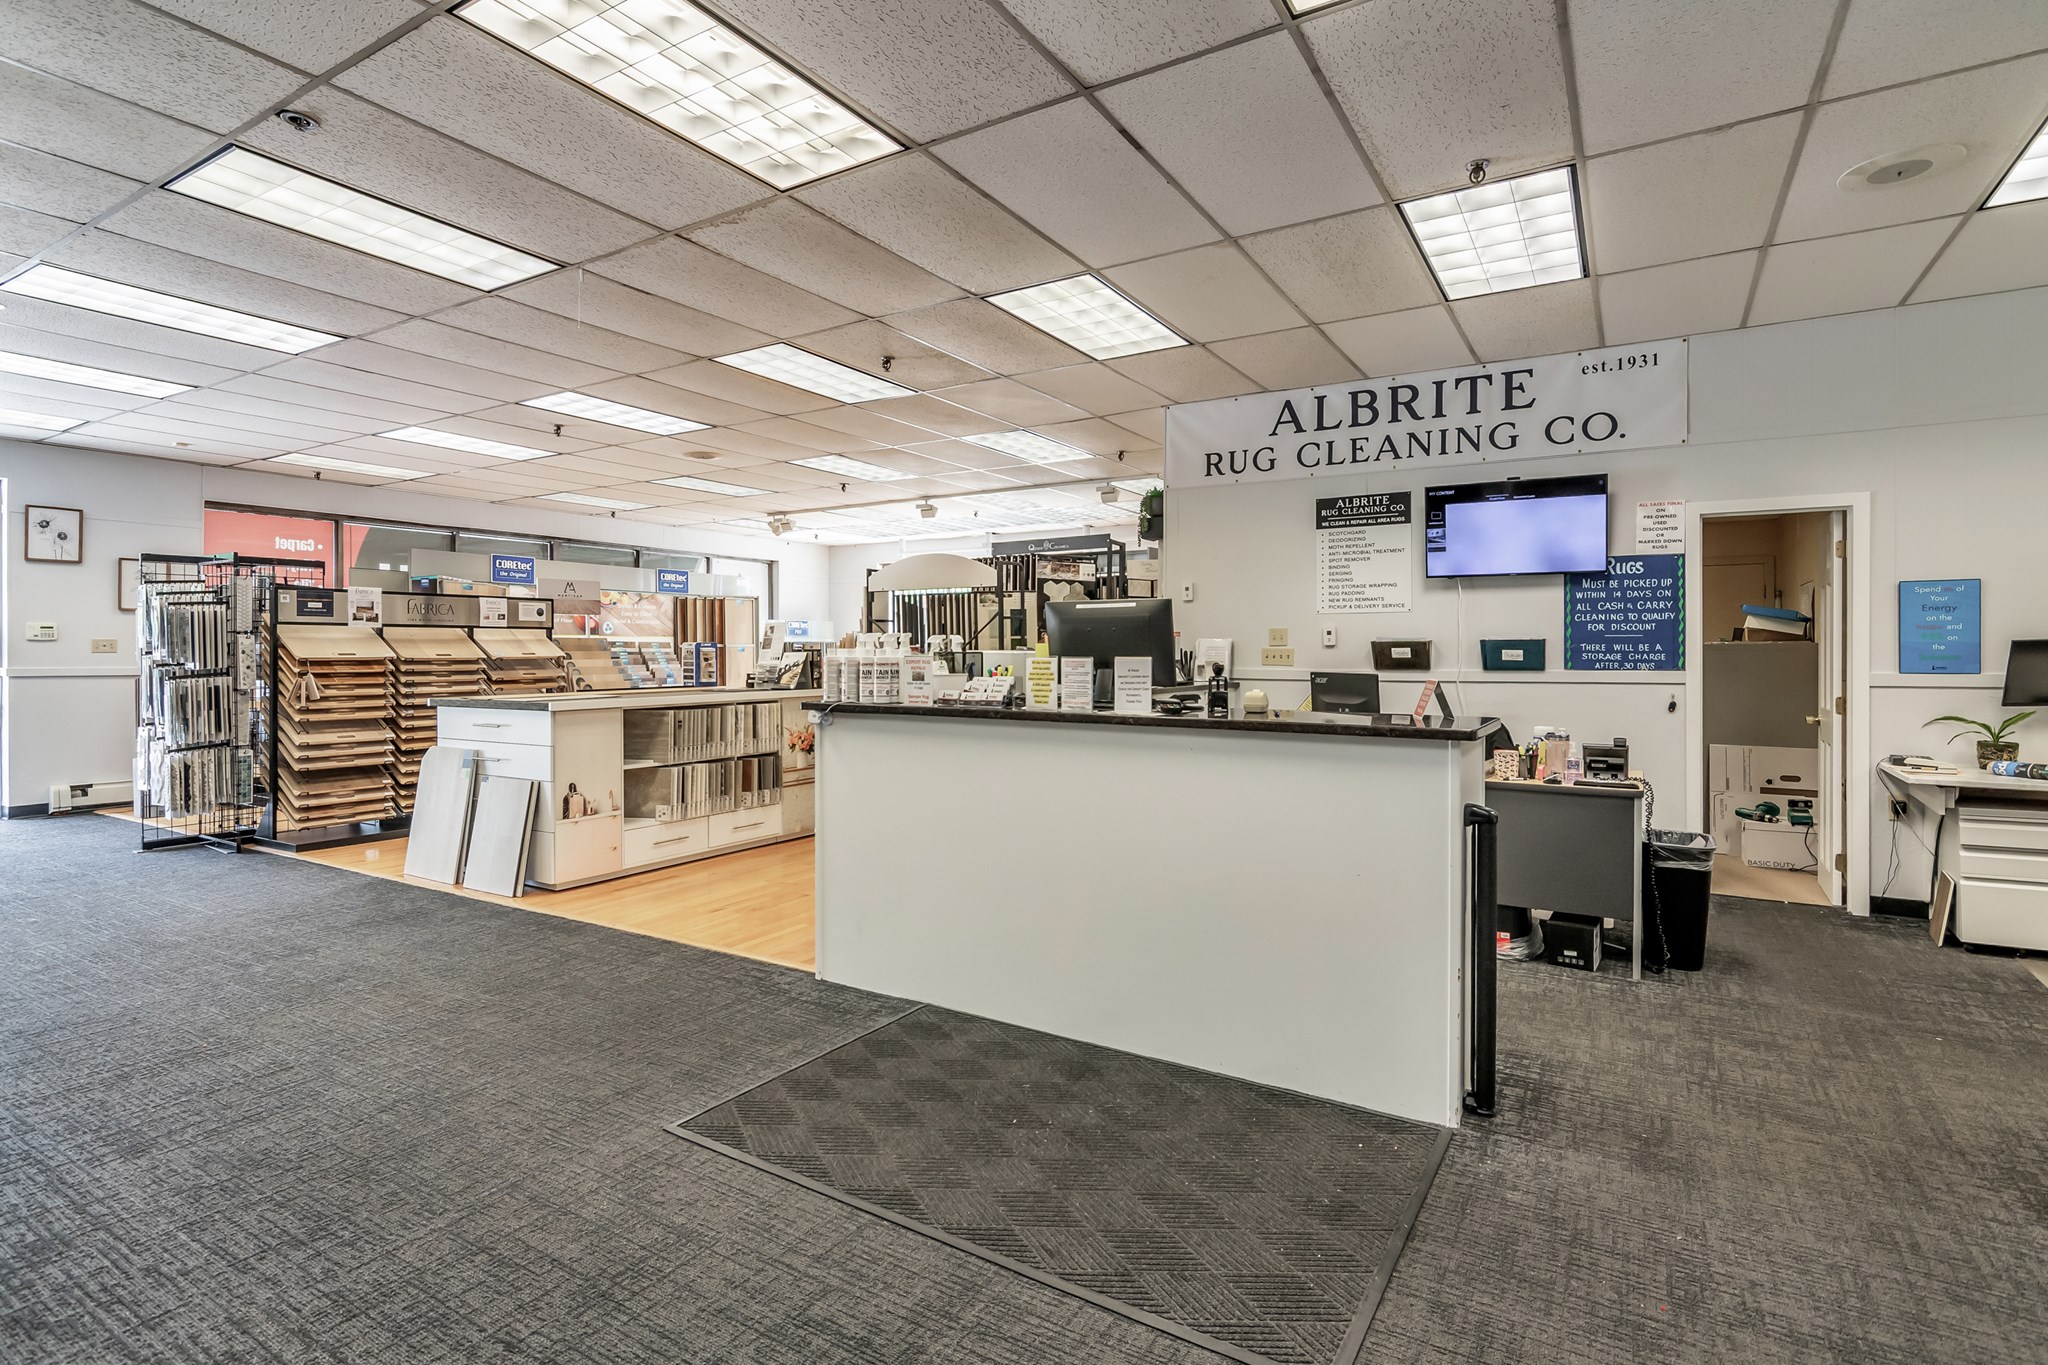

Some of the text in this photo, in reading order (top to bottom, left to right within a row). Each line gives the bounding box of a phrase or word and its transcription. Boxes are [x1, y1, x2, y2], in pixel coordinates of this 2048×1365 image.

[1581, 352, 1660, 375] est.1931
[1268, 368, 1537, 437] ALBRITE
[1204, 412, 1626, 477] RUG CLEANING CO.
[1336, 495, 1390, 508] ALBRITE
[1342, 506, 1387, 515] CLEANING
[496, 559, 532, 570] COREtec
[1609, 579, 1619, 588] BE
[1624, 579, 1658, 588] PICKED
[1661, 578, 1673, 587] UP
[1576, 591, 1606, 599] WITHIN
[1627, 590, 1652, 598] DAYS
[1914, 585, 1941, 594] Spend
[407, 598, 455, 616] FABRICA
[1576, 603, 1591, 611] ALL
[1597, 602, 1624, 610] CASH
[1637, 601, 1673, 610] CARRY
[1922, 604, 1957, 613] Energy
[1574, 612, 1676, 622] CLEANING TO QUALIFY
[1588, 623, 1656, 632] FOR DISCOUNT
[1580, 643, 1606, 651] THERE
[1639, 643, 1650, 651] BE
[1624, 662, 1634, 670] 30
[1747, 859, 1772, 867] BASIC
